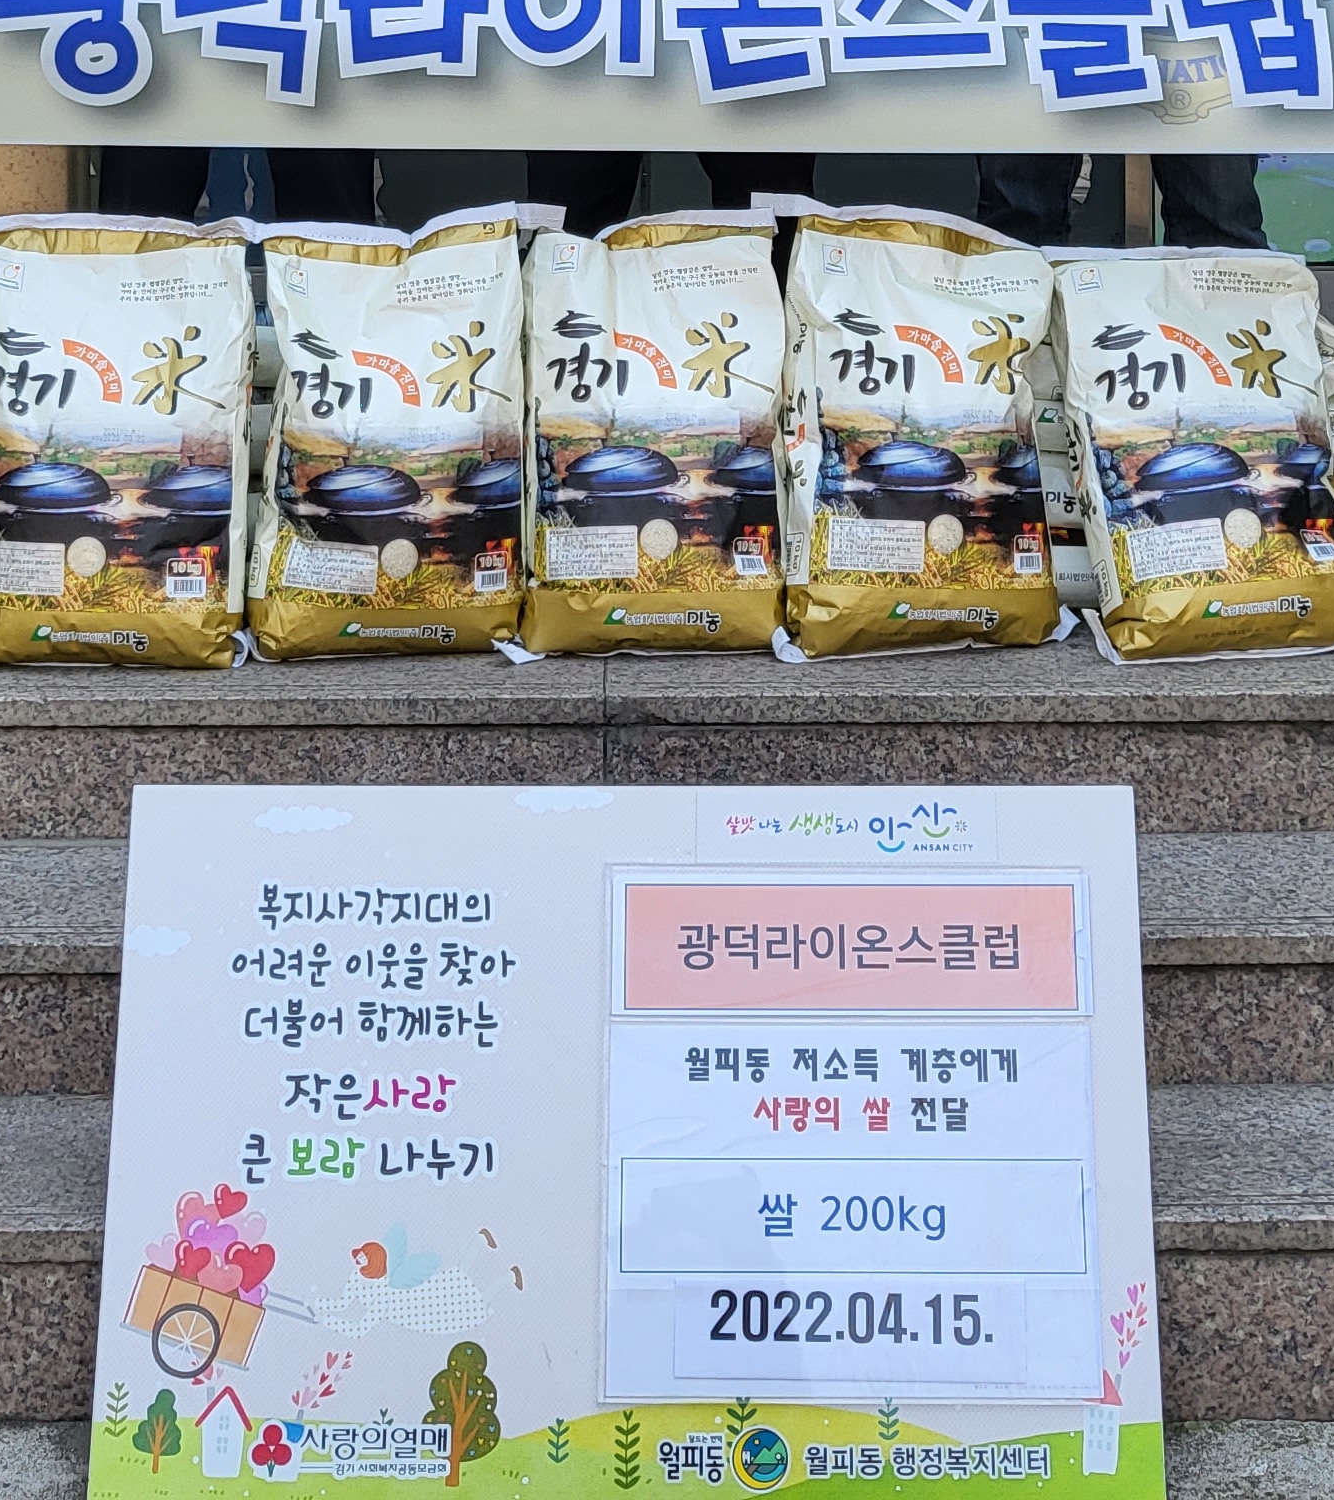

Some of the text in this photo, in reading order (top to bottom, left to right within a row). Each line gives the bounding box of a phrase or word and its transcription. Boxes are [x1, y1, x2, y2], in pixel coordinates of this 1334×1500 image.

[73, 344, 121, 394] 가마솥 진미
[546, 343, 629, 401] 경기
[621, 337, 673, 380] 가마솥 진미
[829, 340, 915, 394] 경기
[906, 329, 959, 374] 가마솥 진미
[1172, 330, 1227, 378] 가마솥 진미
[290, 363, 373, 418] 경기
[365, 355, 418, 396] 가마솥 진미
[1093, 351, 1186, 410] 경기
[1045, 492, 1077, 514] 미농
[479, 554, 505, 568] 10kg
[687, 611, 721, 632] 미농
[967, 608, 999, 630] 미농
[1279, 596, 1311, 617] 미농
[113, 632, 147, 652] 미농
[421, 626, 455, 644] 미농
[789, 812, 859, 836] 생생도시
[869, 802, 957, 853] 안산
[913, 844, 973, 852] ANSAN CITY
[259, 884, 491, 930] 복지사각지대의
[232, 942, 517, 990] 어려운 이웃을 찾아
[677, 924, 1021, 970] 광덕라이온스클럽
[244, 1000, 499, 1048] 더불어 함께하는
[685, 1047, 1019, 1084] 월피동 저소득 계층에게
[753, 1096, 969, 1133] 사랑의 쌀 전달
[241, 1134, 495, 1184] 큰 보람 나누기
[757, 1193, 947, 1242] 쌀 200kg
[709, 1288, 994, 1346] 2022.04.15.
[300, 1428, 447, 1460] 사랑의열매
[658, 1440, 725, 1482] 월피동
[805, 1445, 1049, 1478] 월피동 행정복지센터
[335, 1464, 355, 1476] 경기
